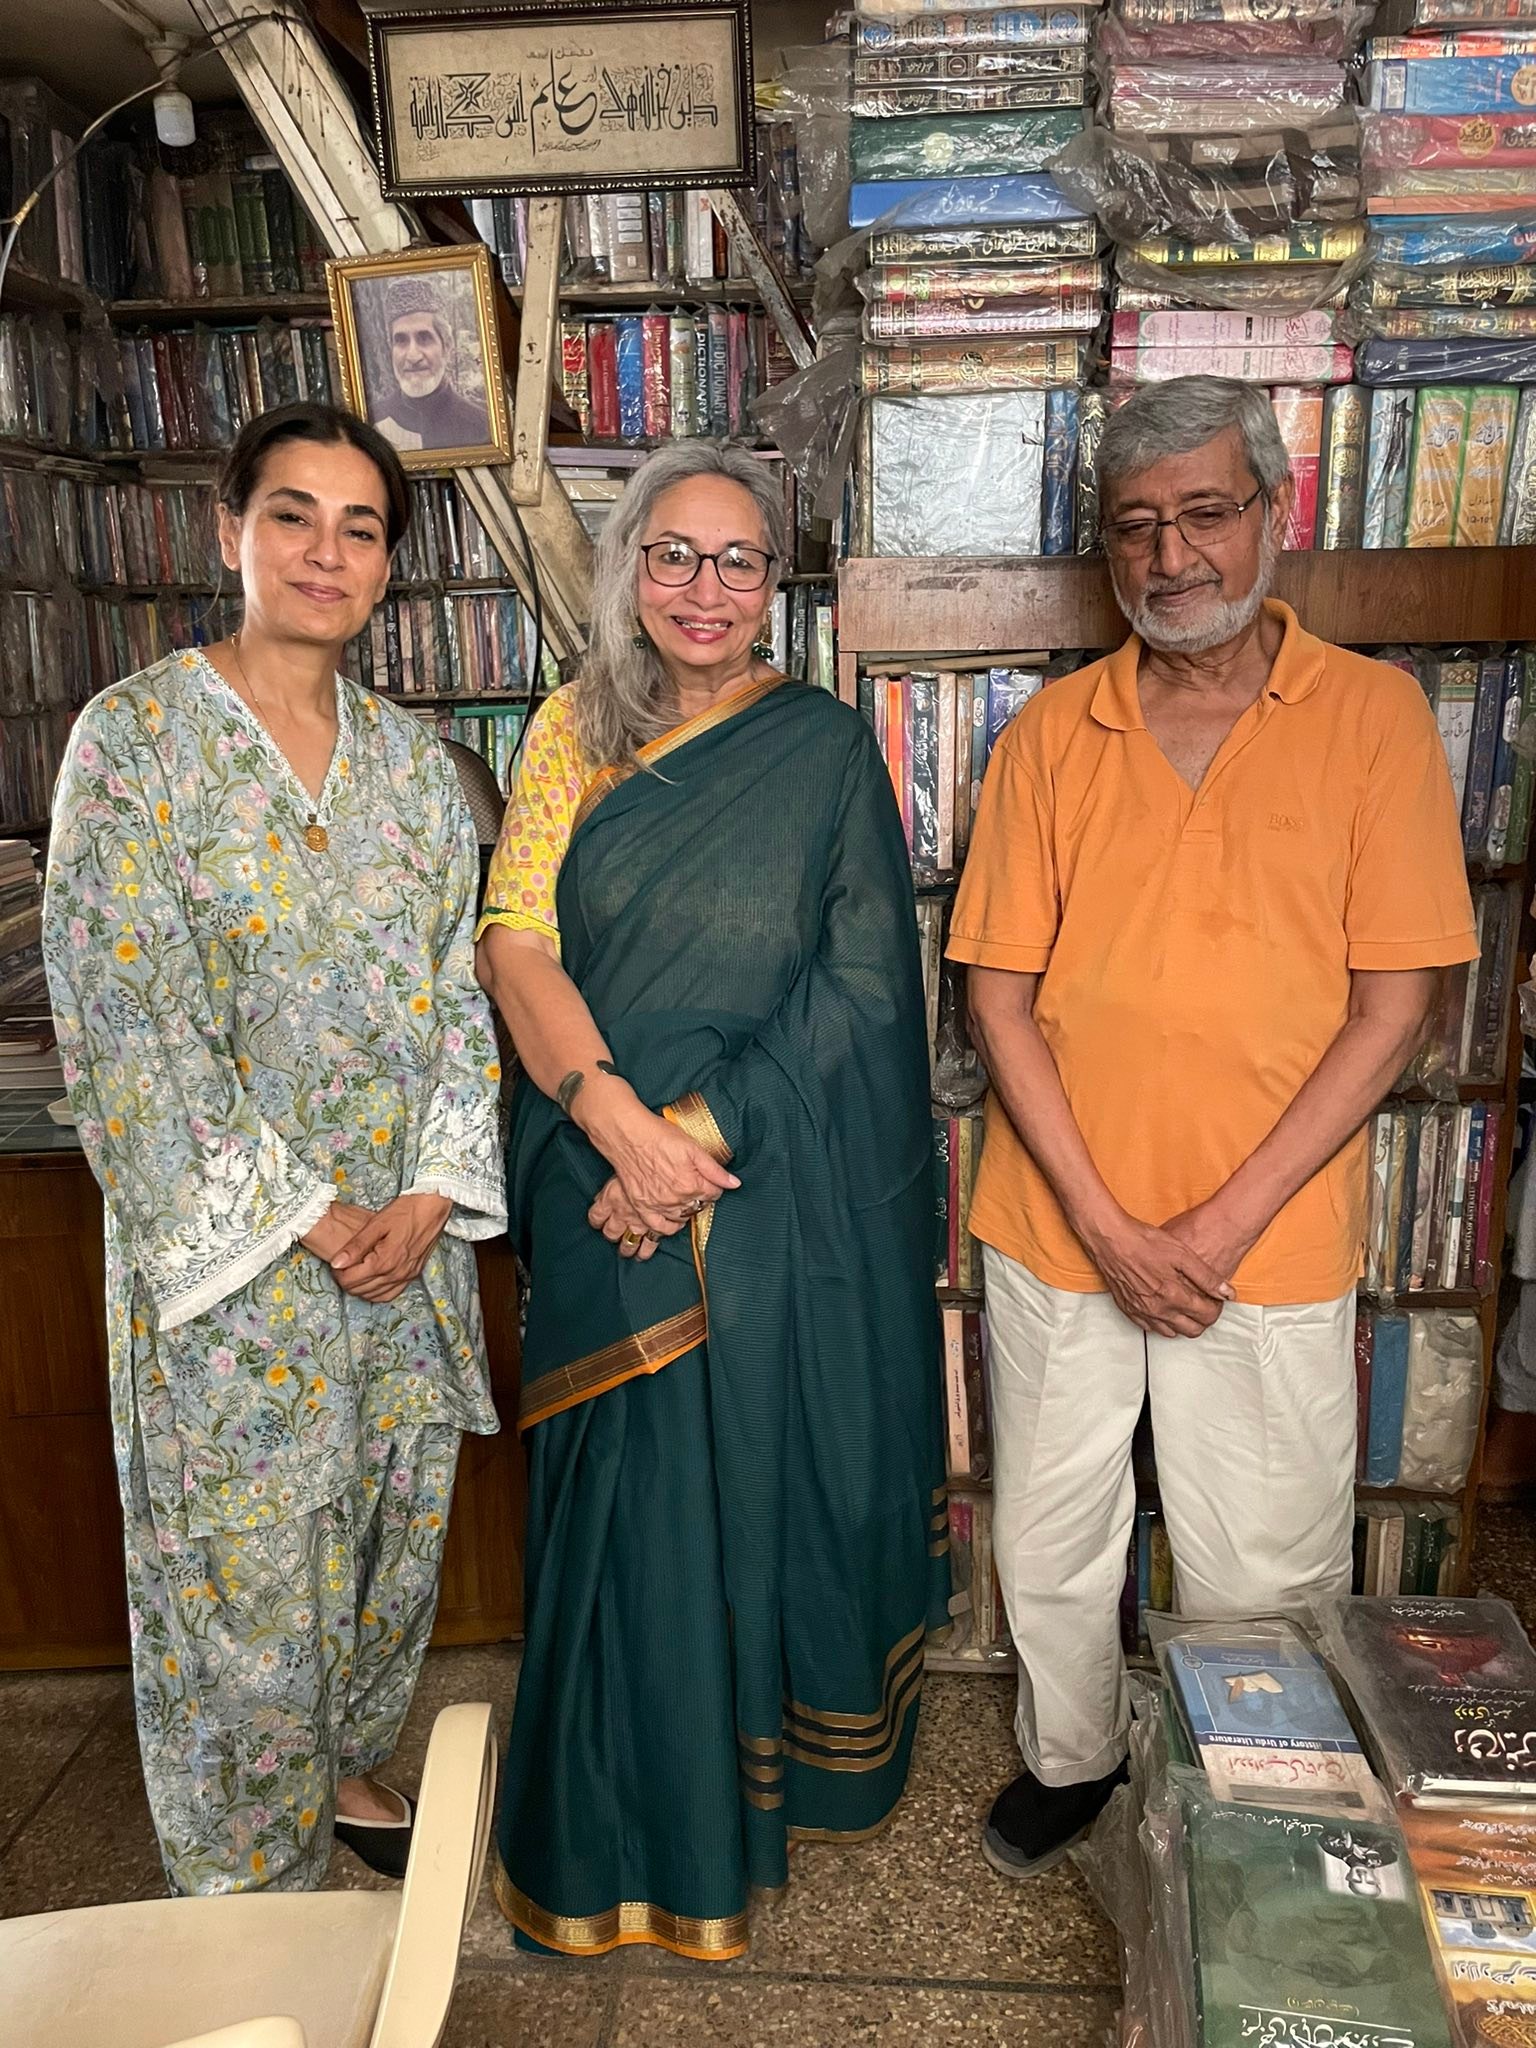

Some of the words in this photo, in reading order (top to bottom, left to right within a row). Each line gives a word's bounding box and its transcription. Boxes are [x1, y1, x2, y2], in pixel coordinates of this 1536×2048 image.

[530, 47, 598, 157] علم
[695, 332, 708, 415] DICTIONARY
[713, 351, 727, 416] DICTIONARY
[798, 608, 806, 659] DICTIONARY
[1208, 1735, 1253, 1746] Literature
[1255, 1737, 1277, 1748] Urdu
[1278, 1739, 1289, 1749] of
[1290, 1739, 1322, 1751] History
[1287, 1759, 1305, 1782] کی
[1305, 1760, 1346, 1783] تاریخ
[1301, 1822, 1324, 1837] ملک
[1452, 1963, 1491, 1982] اولاد
[1241, 2012, 1262, 2039] ہم
